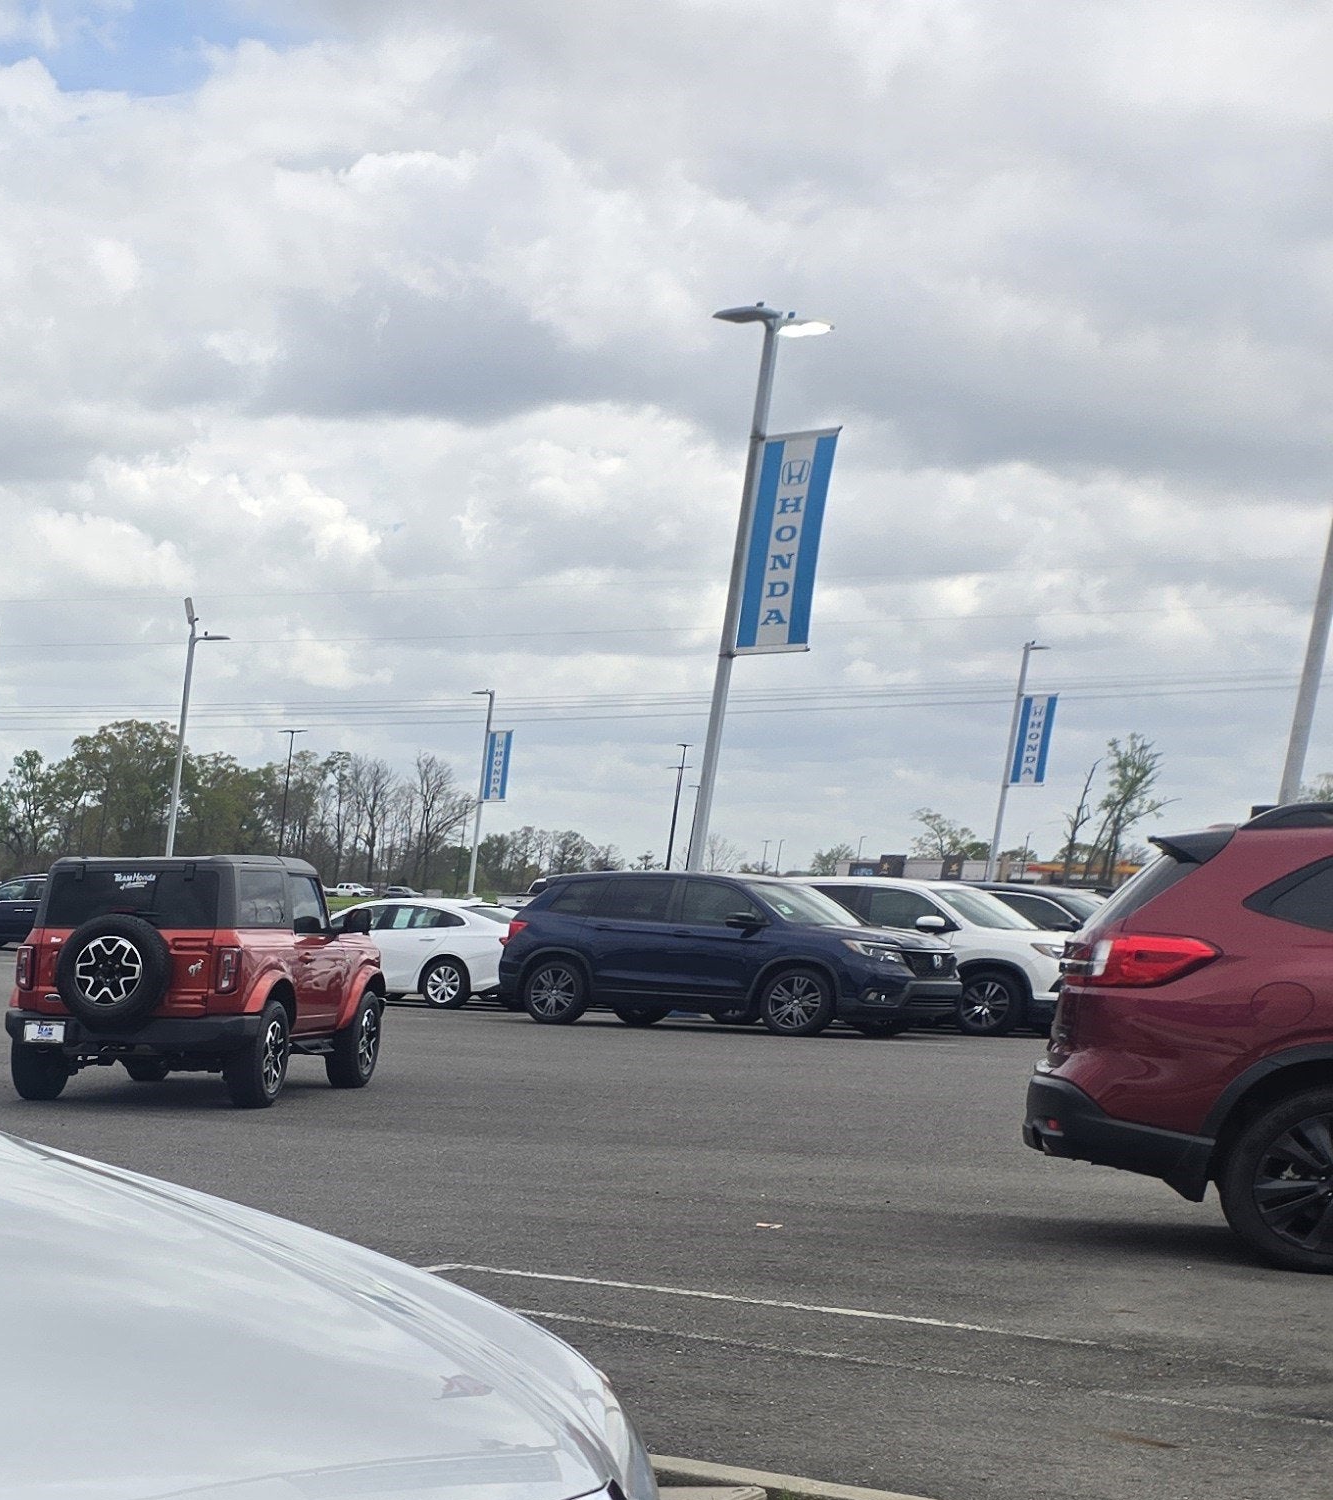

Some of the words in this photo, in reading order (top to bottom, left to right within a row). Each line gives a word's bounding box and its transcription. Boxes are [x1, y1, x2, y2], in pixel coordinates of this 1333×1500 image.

[761, 496, 804, 626] HONDA
[491, 751, 503, 793] HONDA
[1022, 720, 1043, 776] HONDA
